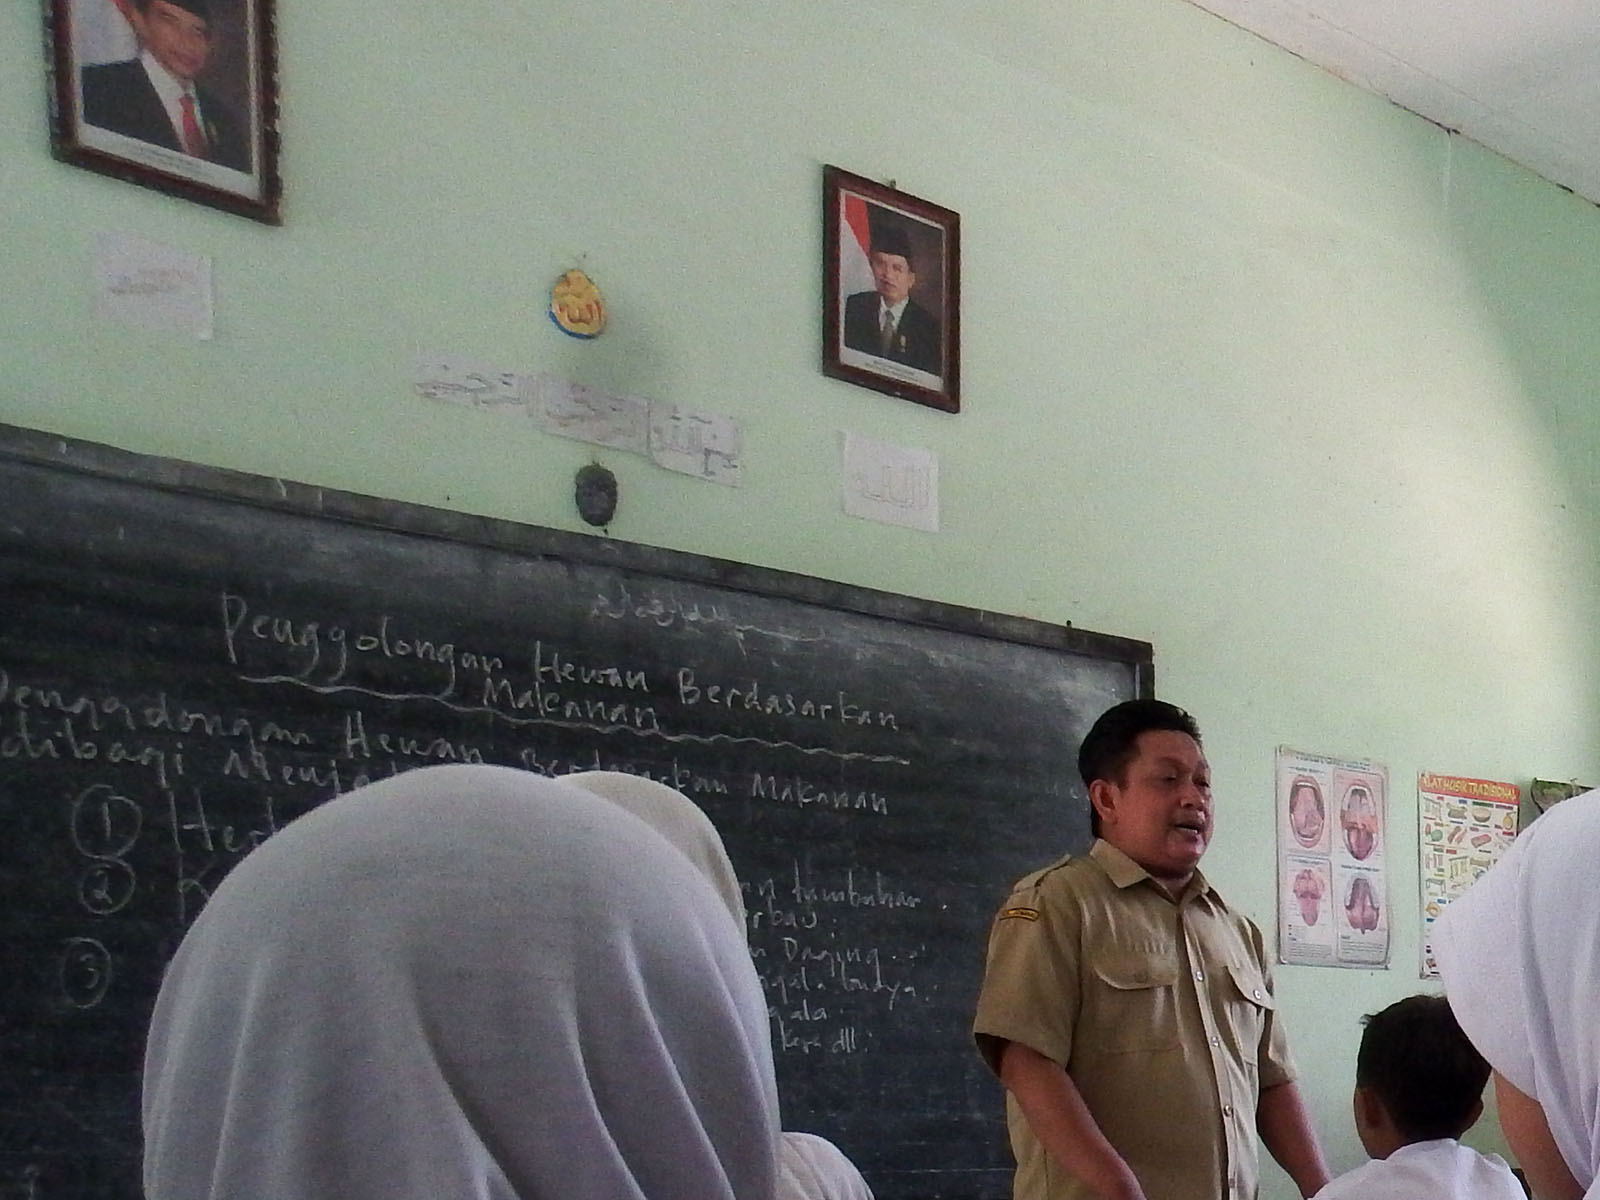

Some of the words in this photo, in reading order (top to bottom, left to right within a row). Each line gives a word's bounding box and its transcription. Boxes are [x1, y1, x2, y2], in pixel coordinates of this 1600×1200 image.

[483, 676, 661, 730] Makanan
[536, 641, 648, 693] Hewan
[678, 667, 898, 731] Berdasarkan
[345, 710, 483, 764] Hewan
